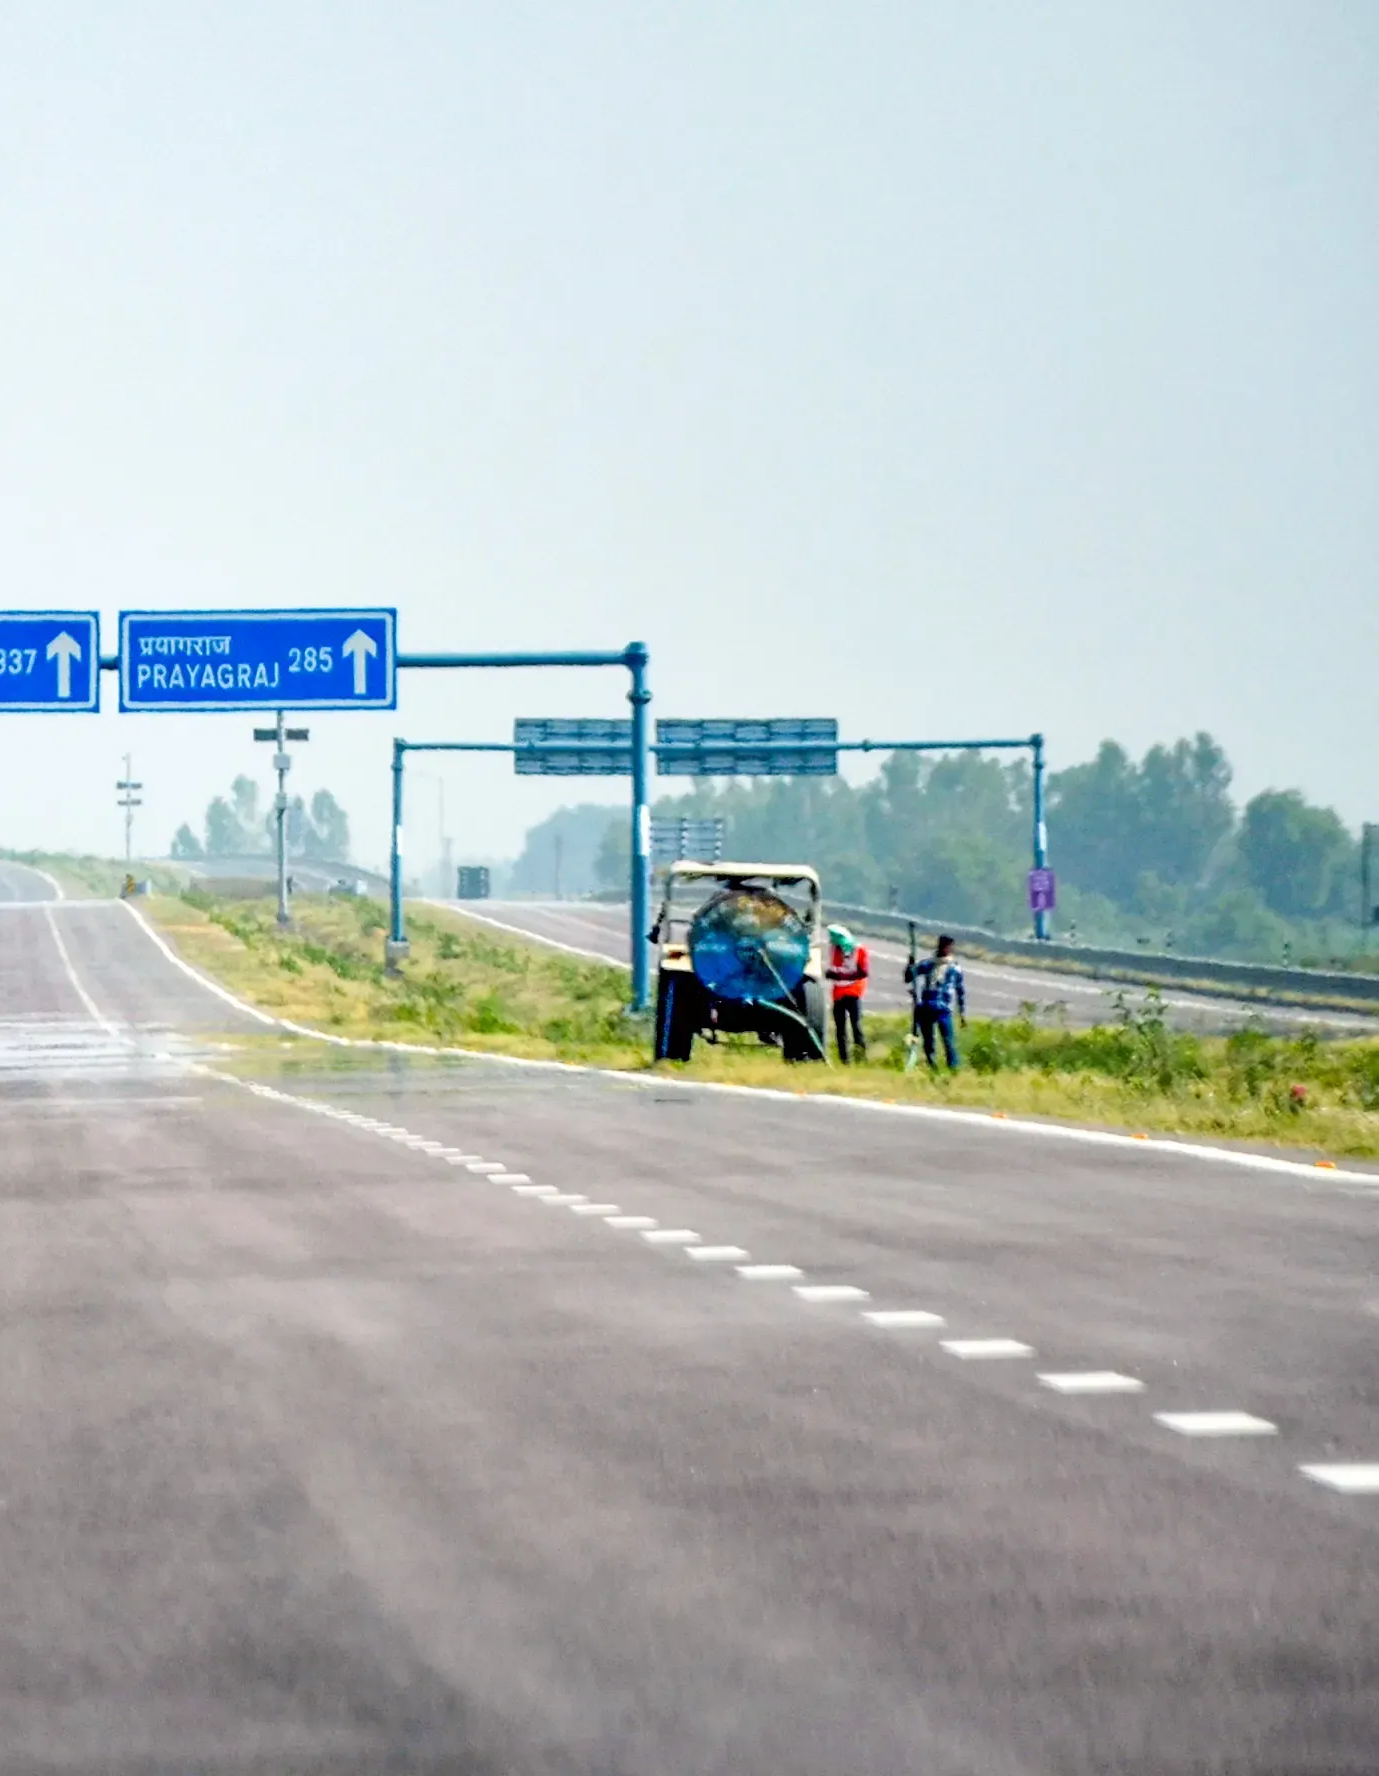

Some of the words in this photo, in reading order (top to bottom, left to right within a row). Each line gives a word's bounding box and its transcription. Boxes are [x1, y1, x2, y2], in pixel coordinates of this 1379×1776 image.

[137, 635, 233, 657] प्रयागराज
[287, 646, 334, 673] 285
[137, 661, 281, 690] PRAYAGRAJ
